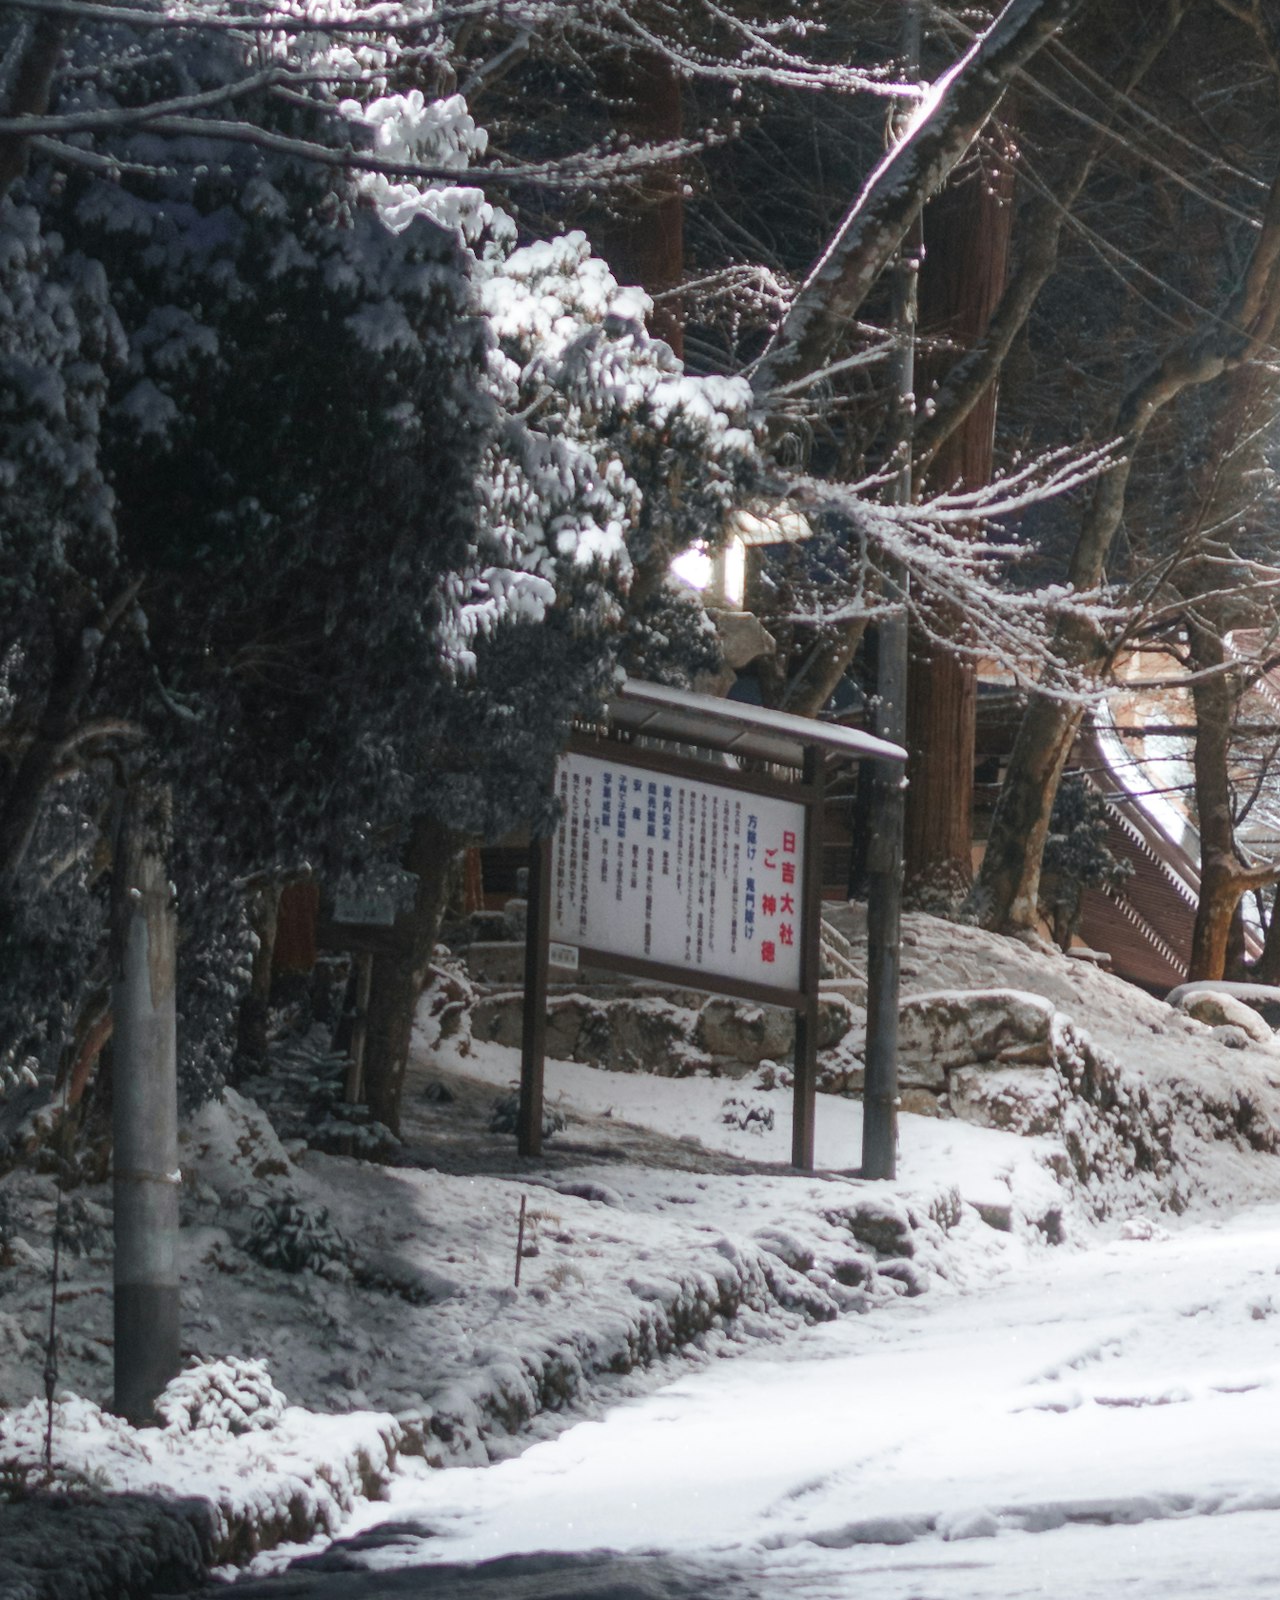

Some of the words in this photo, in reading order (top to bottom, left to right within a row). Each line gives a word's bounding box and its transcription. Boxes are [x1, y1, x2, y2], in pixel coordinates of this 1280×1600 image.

[761, 848, 777, 962] ご神徳
[780, 831, 796, 945] 日吉大社
